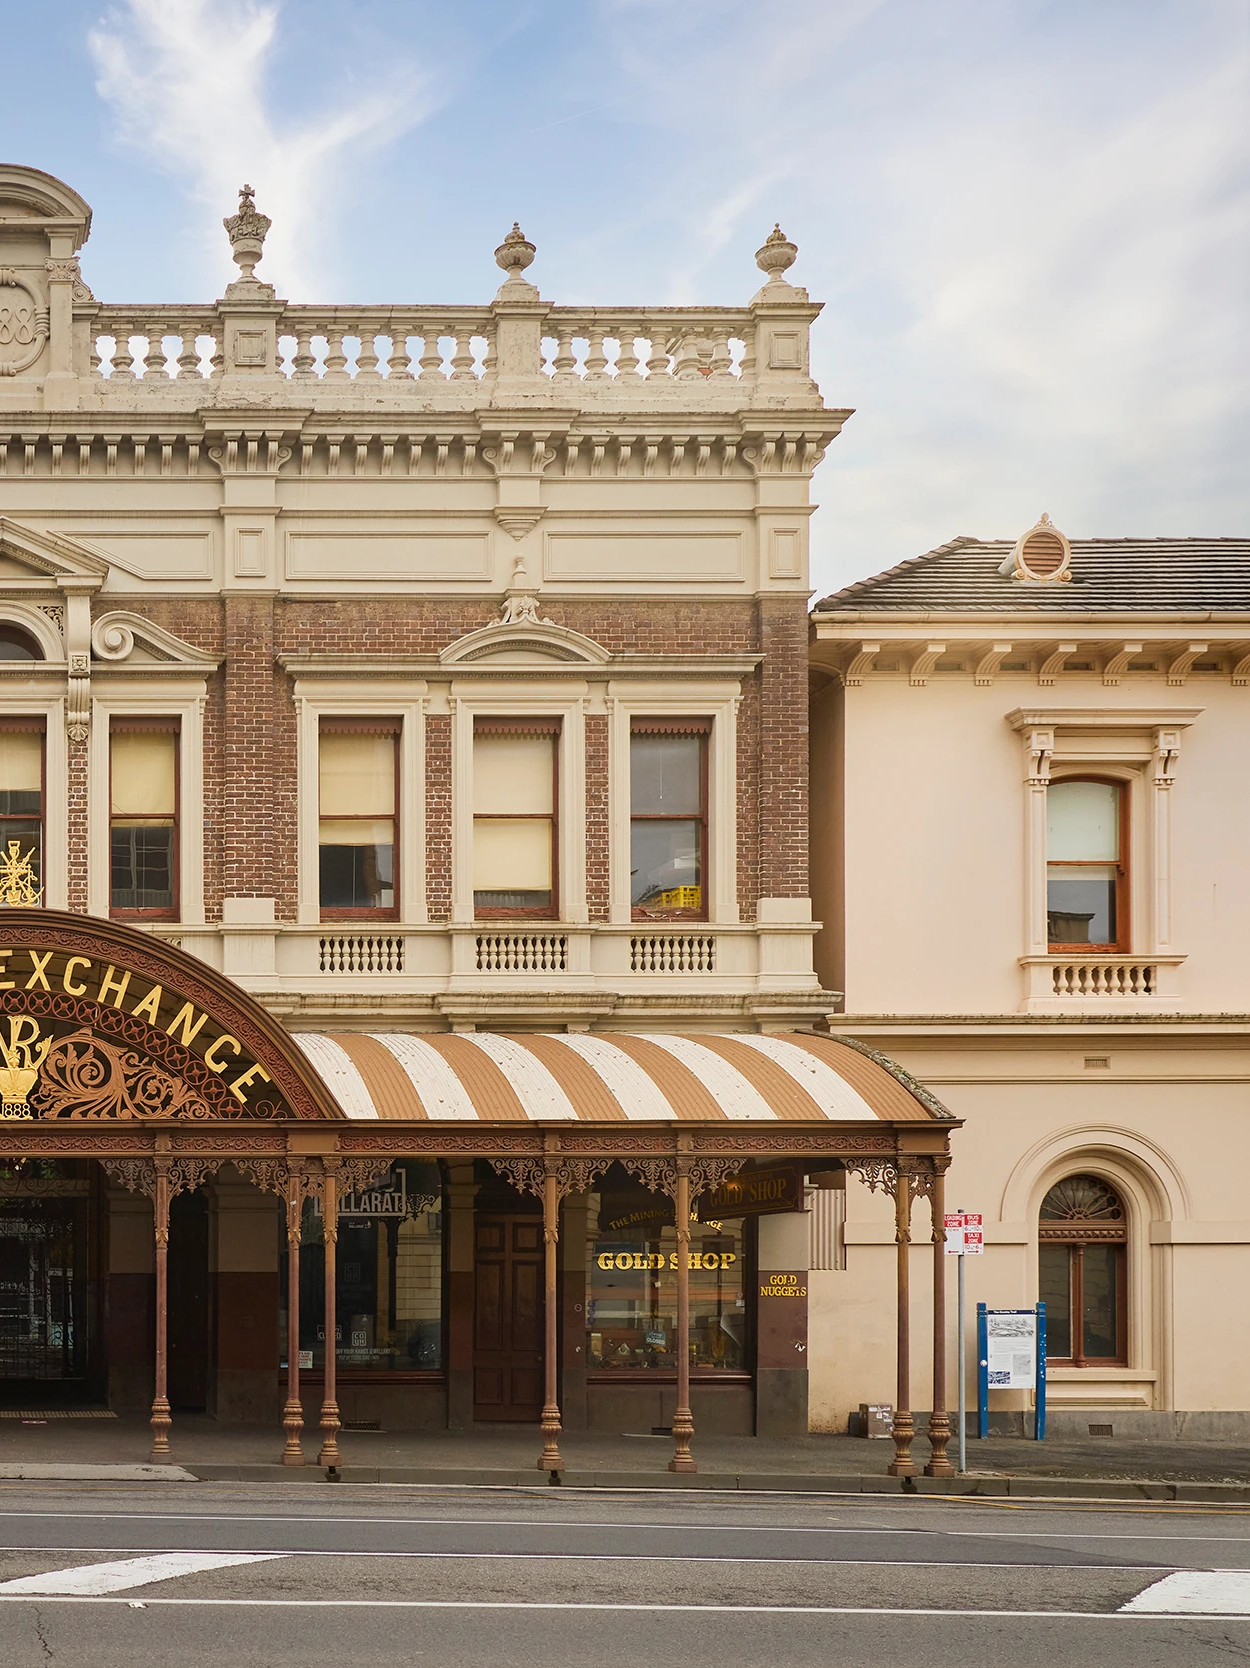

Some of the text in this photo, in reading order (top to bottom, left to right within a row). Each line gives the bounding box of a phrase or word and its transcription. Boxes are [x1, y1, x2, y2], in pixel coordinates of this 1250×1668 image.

[1, 1103, 31, 1117] 1888
[749, 1178, 787, 1202] SHOP
[608, 1218, 630, 1231] THE
[629, 1209, 669, 1223] MINING
[597, 1252, 737, 1271] GOLD SHOP
[760, 1274, 807, 1297] GOLD NUGGETS
